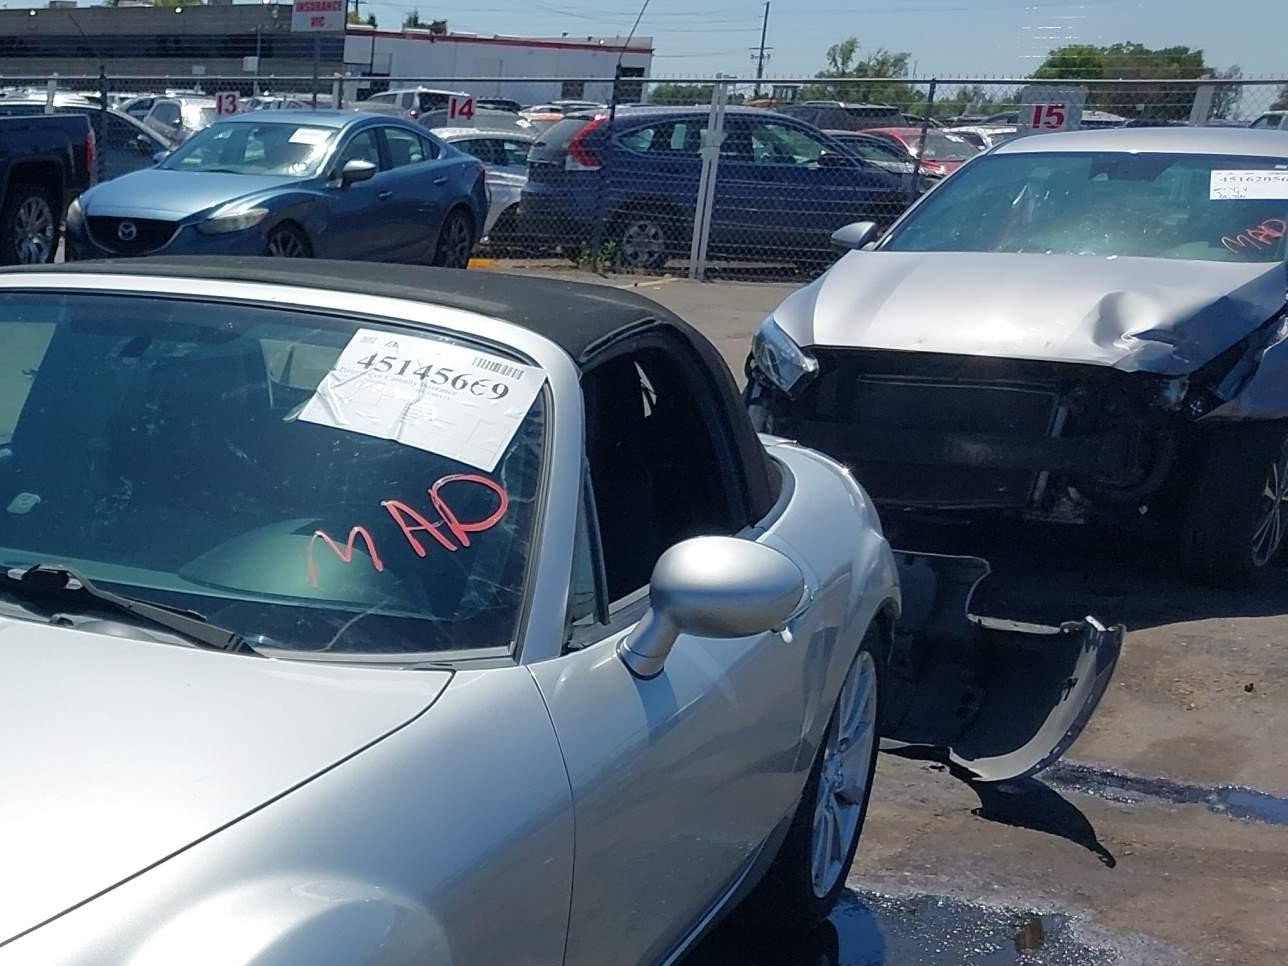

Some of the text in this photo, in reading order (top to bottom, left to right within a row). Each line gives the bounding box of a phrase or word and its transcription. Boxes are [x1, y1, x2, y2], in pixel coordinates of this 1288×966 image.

[295, 1, 342, 12] INSURANCE
[216, 94, 238, 115] 13
[450, 96, 474, 120] 14
[1032, 103, 1065, 129] 15
[1221, 218, 1286, 254] MAD
[357, 352, 510, 400] 45145669
[309, 474, 509, 588] MAD
